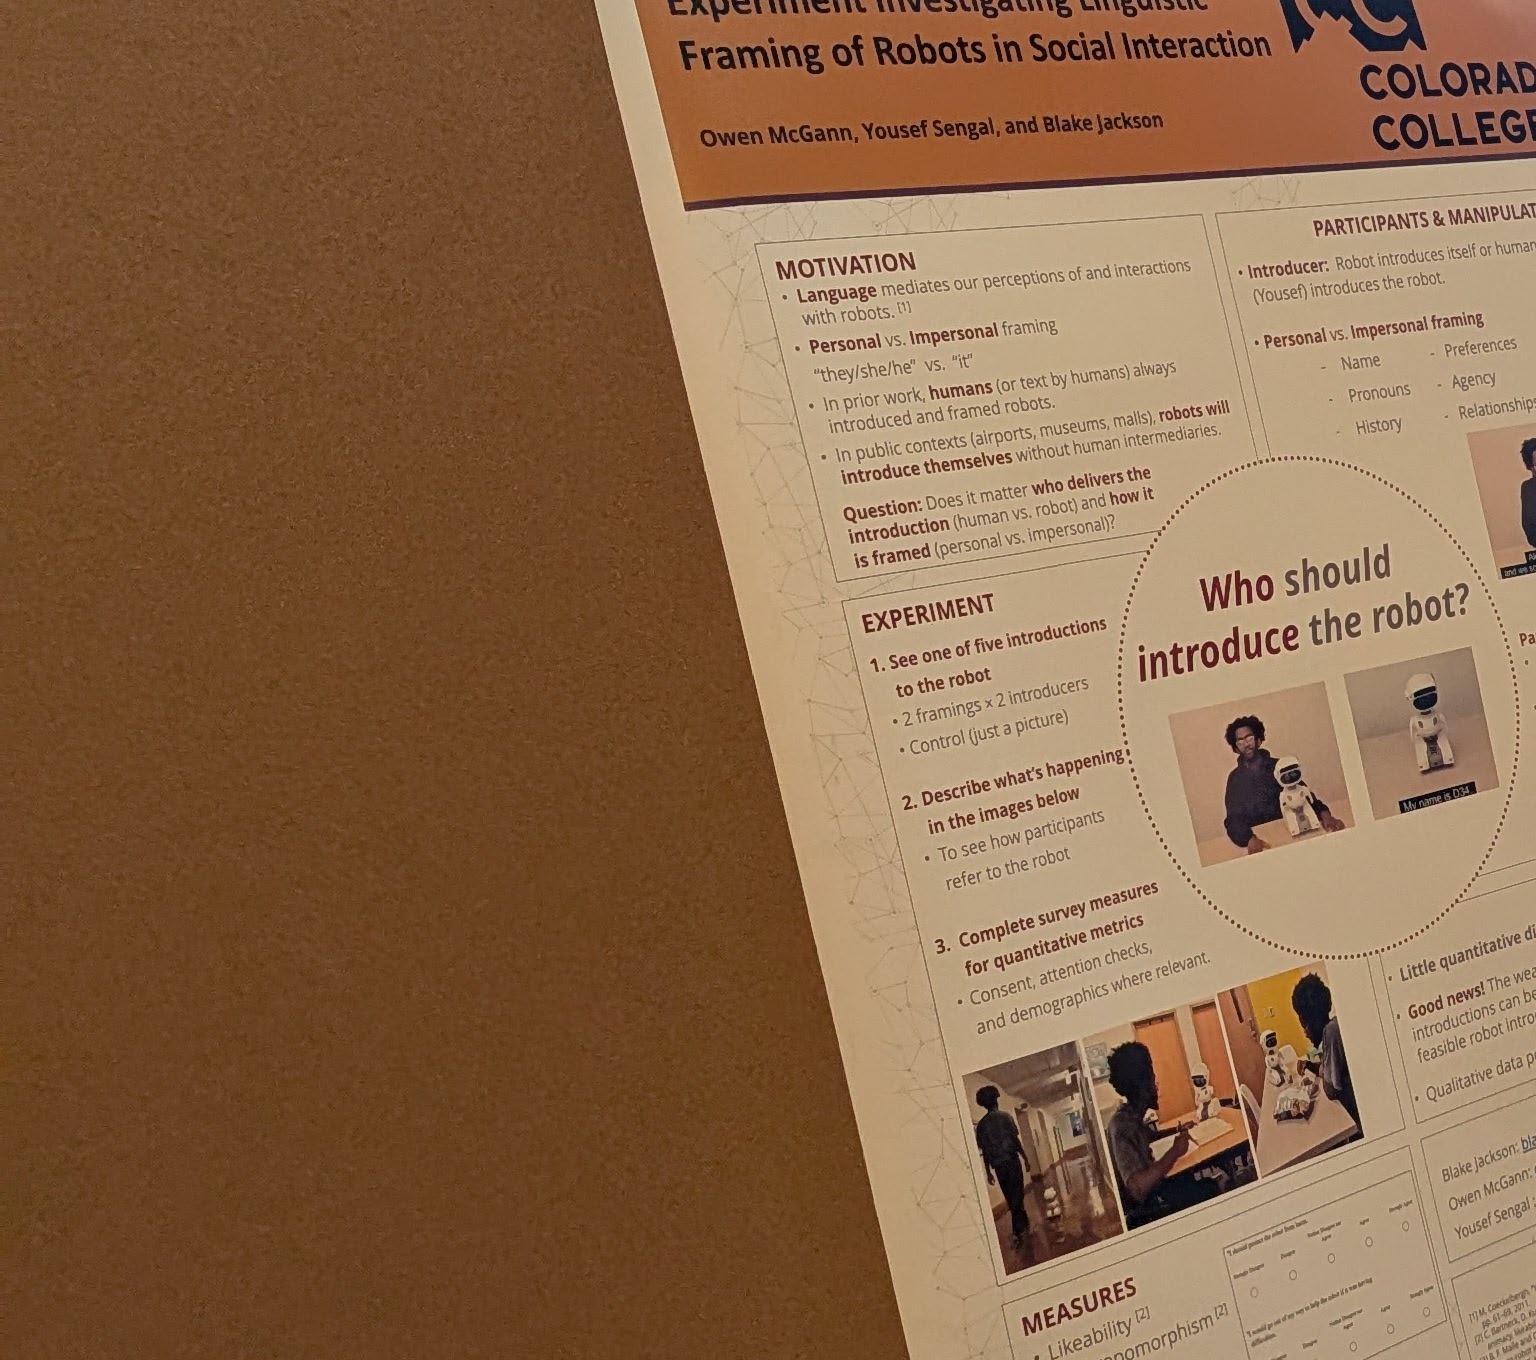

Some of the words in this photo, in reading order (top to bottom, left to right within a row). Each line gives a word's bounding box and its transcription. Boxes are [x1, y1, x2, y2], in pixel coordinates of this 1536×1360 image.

[678, 37, 824, 74] Framing
[831, 34, 864, 66] of
[872, 33, 986, 65] Robots
[991, 33, 1023, 62] in
[1028, 30, 1116, 62] Social
[1121, 29, 1272, 59] Interaction
[699, 129, 764, 147] Owen
[767, 124, 859, 144] McGann,
[861, 119, 928, 140] Yousef
[932, 116, 1000, 140] Sengal,
[1004, 115, 1039, 134] and
[1042, 113, 1093, 133] Blake
[1096, 111, 1163, 135] Jackson
[1312, 211, 1429, 237] PARTICIPANTS
[1432, 210, 1446, 227] &
[775, 251, 916, 280] MOTIVATION
[1247, 259, 1330, 279] Introducer:
[1334, 254, 1376, 271] Robot
[1376, 248, 1445, 266] introduces
[1446, 242, 1476, 260] itself
[1479, 245, 1492, 256] or
[796, 285, 877, 305] Language
[880, 278, 950, 296] mediates
[953, 277, 978, 290] our
[982, 269, 1065, 292] perceptions
[1068, 265, 1081, 281] of
[1085, 264, 1111, 280] and
[1113, 260, 1191, 277] interactions
[808, 332, 882, 354] Personal
[884, 335, 906, 347] vs.
[909, 321, 999, 347] Impersonal
[1001, 318, 1058, 336] framing
[1444, 338, 1517, 358] Preferences
[1340, 355, 1381, 370] Name
[1452, 372, 1495, 392] Agency
[1348, 384, 1411, 403] Pronouns
[835, 447, 851, 462] In
[855, 440, 902, 464] public
[905, 435, 967, 454] contexts
[970, 427, 1036, 449] (airports,
[1039, 418, 1110, 437] museums,
[1113, 410, 1156, 428] malls),
[1158, 405, 1203, 422] robots
[1205, 399, 1230, 416] will
[1355, 417, 1401, 435] History
[840, 463, 920, 484] introduce
[923, 451, 1013, 474] themselves
[1015, 443, 1070, 462] without
[1072, 438, 1120, 454] human
[1123, 423, 1221, 448] intermediaries.
[1199, 569, 1274, 612] Who
[1284, 543, 1390, 596] should
[861, 592, 993, 633] EXPERIMENT
[1138, 624, 1299, 682] introduce
[1308, 607, 1361, 646] the
[1372, 582, 1469, 633] robot?
[869, 657, 886, 673] 1.
[888, 654, 918, 670] See
[922, 647, 952, 663] one
[955, 639, 970, 657] of
[973, 637, 1003, 654] five
[1005, 618, 1107, 648] introductions
[901, 795, 918, 811] 2.
[921, 779, 991, 806] Describe
[1045, 748, 1125, 777] happening
[1418, 795, 1442, 808] name
[1443, 791, 1452, 801] is
[934, 938, 951, 954] 3.
[958, 917, 1035, 947] Complete
[1037, 902, 1085, 926] survey
[1089, 882, 1158, 911] measures
[1399, 958, 1436, 982] Little
[1439, 933, 1521, 972] quantitative
[1426, 1067, 1493, 1103] Qualitative
[1495, 1056, 1524, 1076] data
[1441, 1161, 1473, 1183] Blake
[1473, 1142, 1519, 1173] Jackson:
[1021, 1277, 1136, 1336] MEASURES
[1047, 1317, 1131, 1360] Likeability
